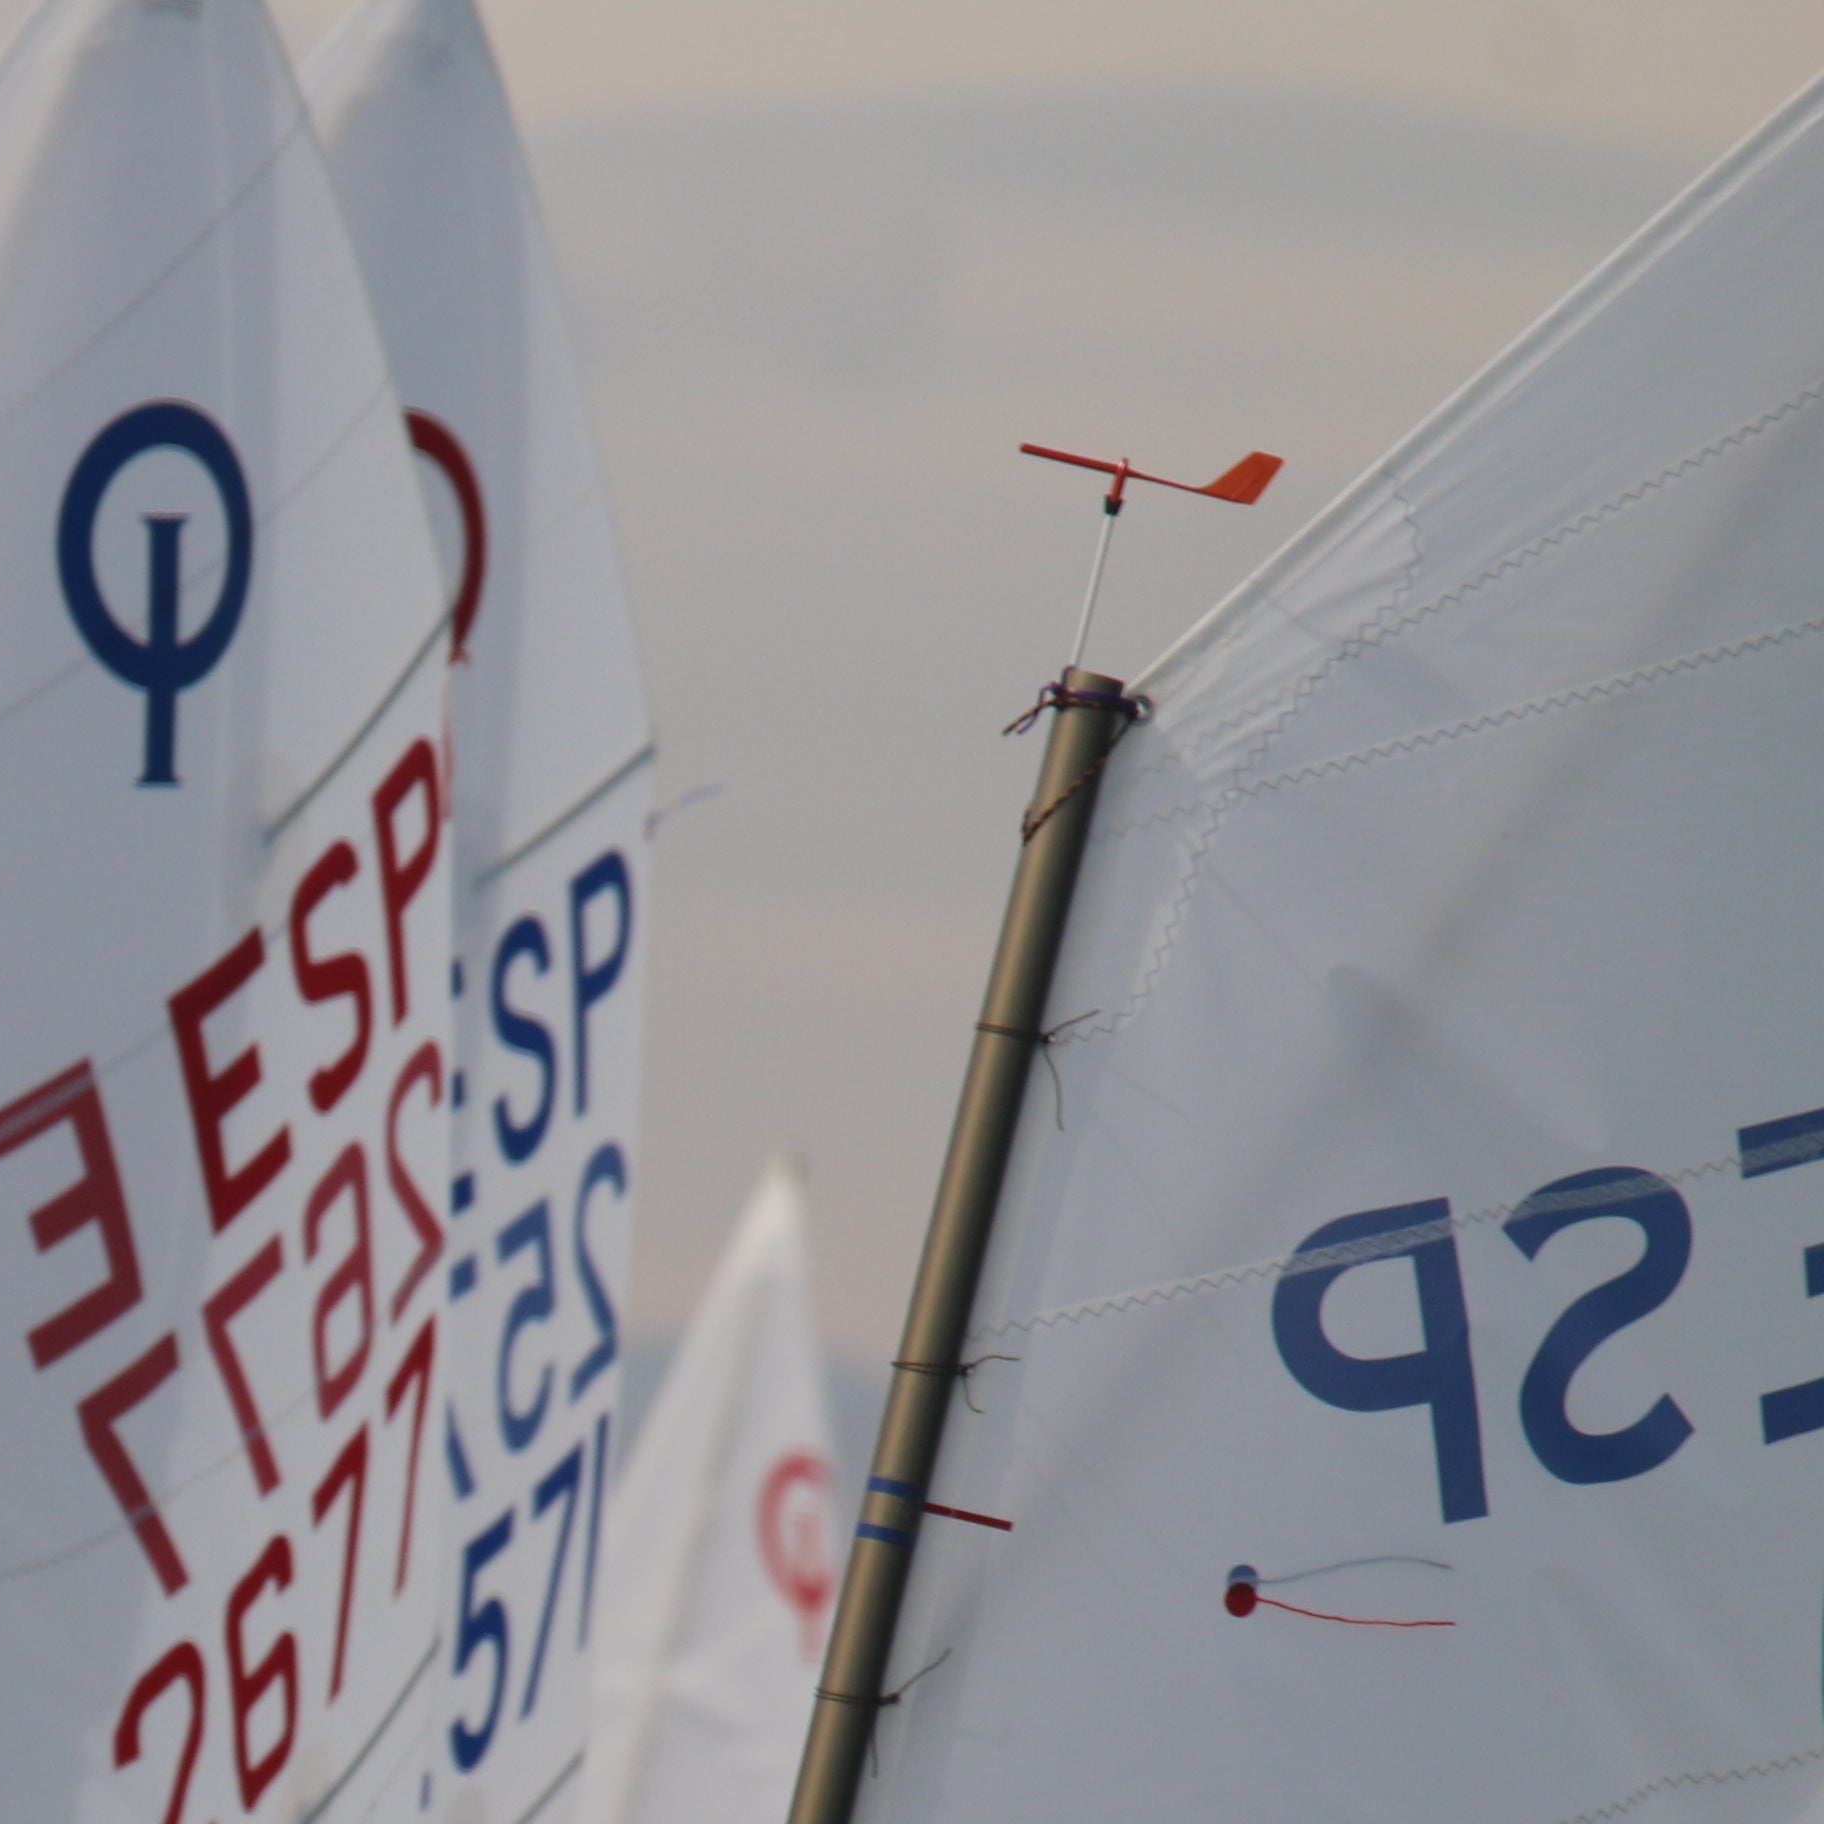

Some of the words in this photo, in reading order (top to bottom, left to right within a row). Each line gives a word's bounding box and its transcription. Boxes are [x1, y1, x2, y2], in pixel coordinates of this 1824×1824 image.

[167, 735, 444, 1240] ESP
[451, 850, 633, 1216] SP
[420, 1412, 608, 1806] 571
